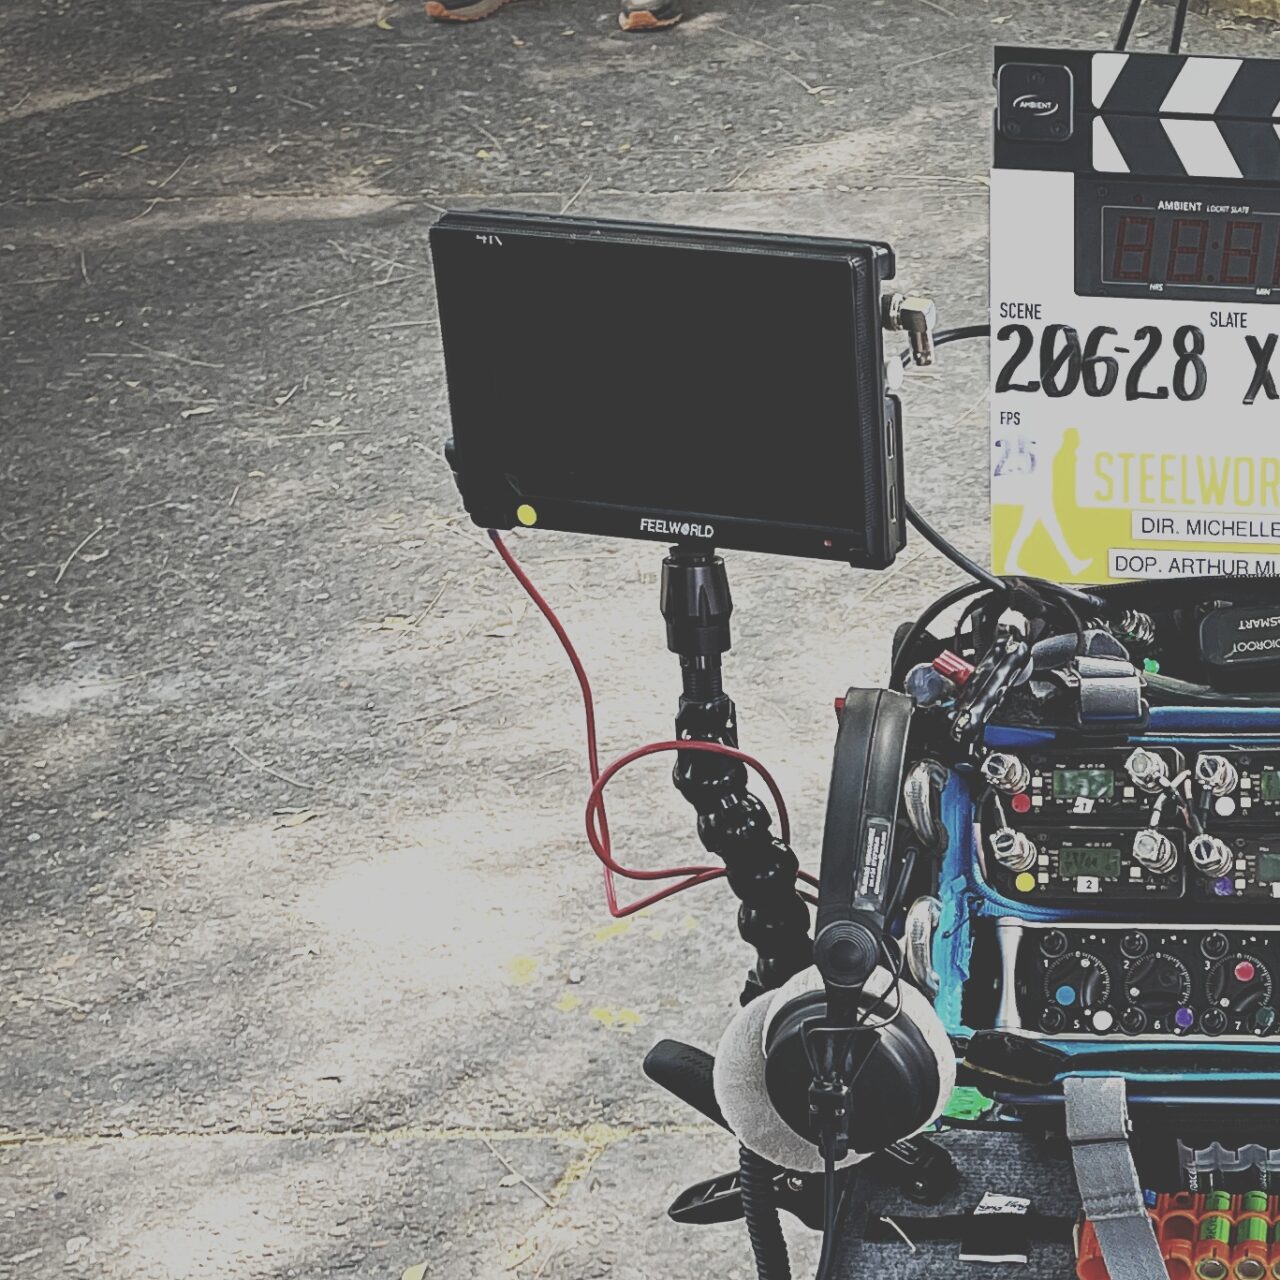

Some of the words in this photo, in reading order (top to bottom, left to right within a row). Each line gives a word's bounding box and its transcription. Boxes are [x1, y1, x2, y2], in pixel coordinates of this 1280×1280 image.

[1157, 200, 1203, 212] AMBIENT
[999, 302, 1042, 320] SCENE
[1209, 311, 1248, 329] SLATE
[999, 411, 1021, 426] FPS
[993, 437, 1038, 478] 25
[639, 518, 715, 539] FEELWORLD
[1141, 517, 1180, 535] DIR.
[1115, 555, 1163, 574] DOP.
[1167, 557, 1250, 577] ARTHUR
[1081, 802, 1088, 811] 1
[1085, 879, 1093, 889] 2
